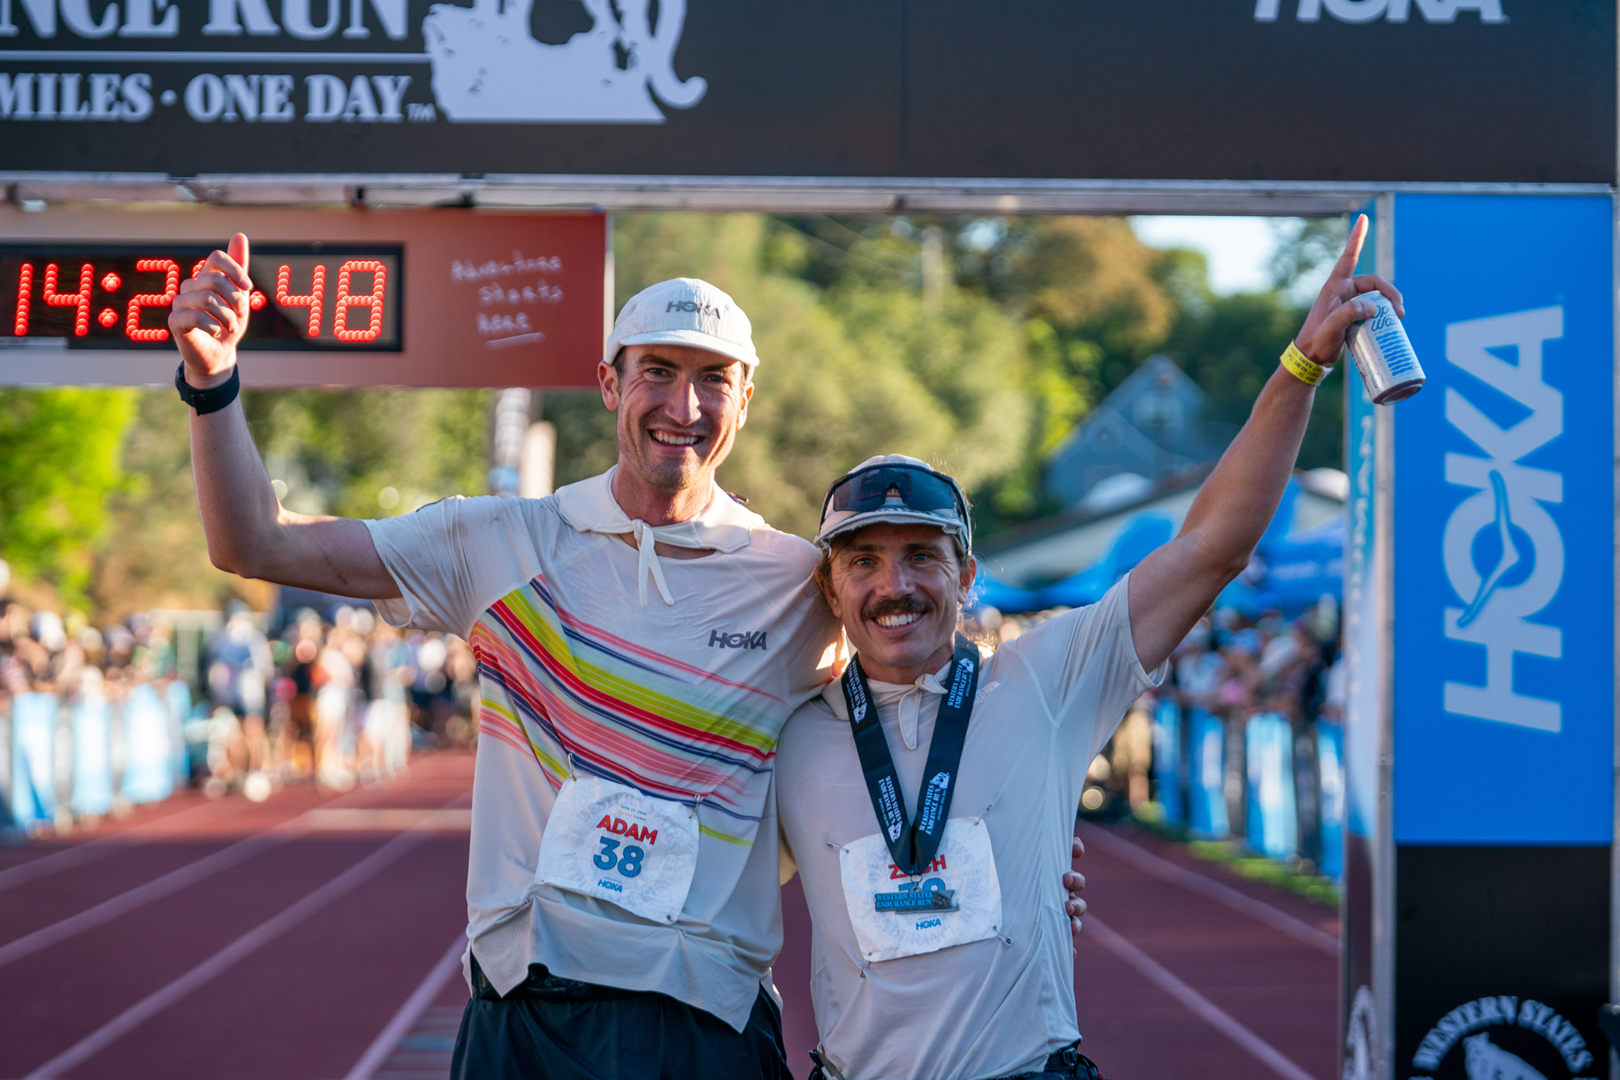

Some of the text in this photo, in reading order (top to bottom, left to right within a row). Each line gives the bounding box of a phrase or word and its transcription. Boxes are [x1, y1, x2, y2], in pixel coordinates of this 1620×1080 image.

[184, 73, 295, 123] ONE
[303, 74, 413, 123] DAY
[14, 259, 388, 343] 14:2:48
[665, 300, 721, 320] HOKA
[1443, 305, 1565, 733] HOKA
[708, 629, 768, 651] HOKA
[596, 814, 659, 846] ADAM
[593, 836, 645, 879] 38
[888, 854, 947, 880] ZH
[597, 878, 623, 894] HOKA
[876, 891, 934, 902] WESTERN STATES
[876, 898, 932, 908] ENDURANCE RUN
[915, 918, 942, 931] HOKA
[1412, 995, 1518, 1071] WESTERN
[1518, 999, 1594, 1074] STATES
